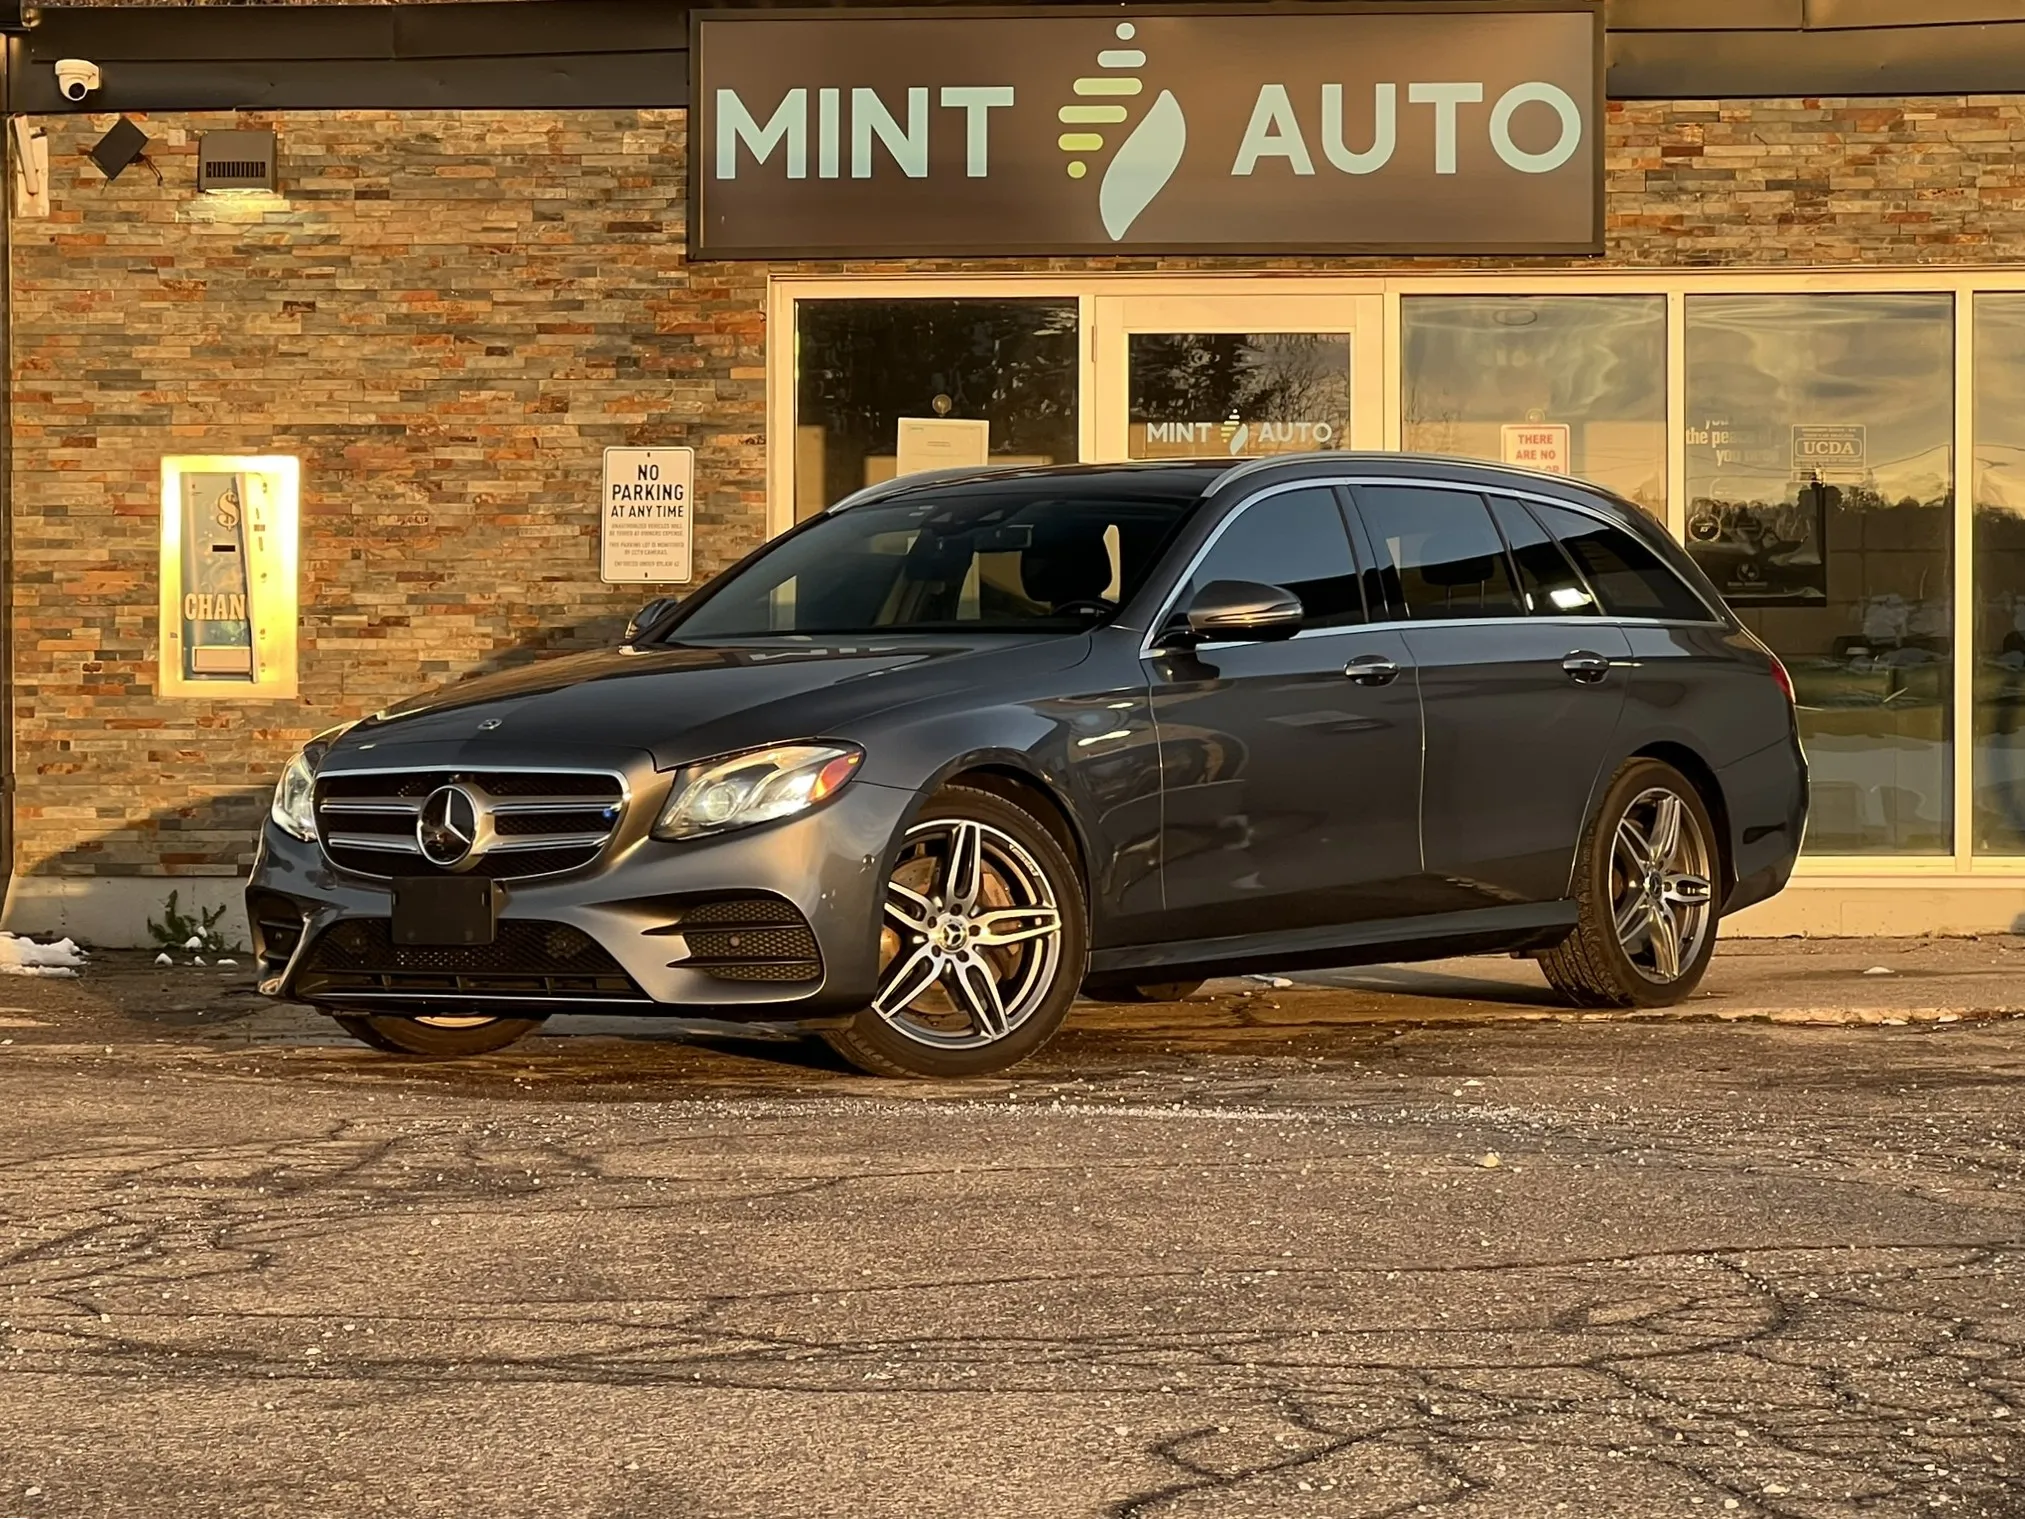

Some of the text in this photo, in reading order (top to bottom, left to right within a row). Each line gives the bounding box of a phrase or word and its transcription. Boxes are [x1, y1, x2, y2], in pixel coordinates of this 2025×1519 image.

[716, 82, 1582, 179] MINT AUTO
[1147, 422, 1332, 442] MINT AUTO
[1518, 434, 1553, 444] THERE
[1686, 427, 1708, 444] the
[1516, 449, 1556, 460] ARE NO
[1803, 441, 1855, 454] UCDA
[1716, 449, 1741, 467] you
[638, 464, 659, 480] NO
[612, 484, 684, 501] PARKING
[611, 505, 684, 518] AT ANY TIME
[184, 593, 246, 621] CHAN
